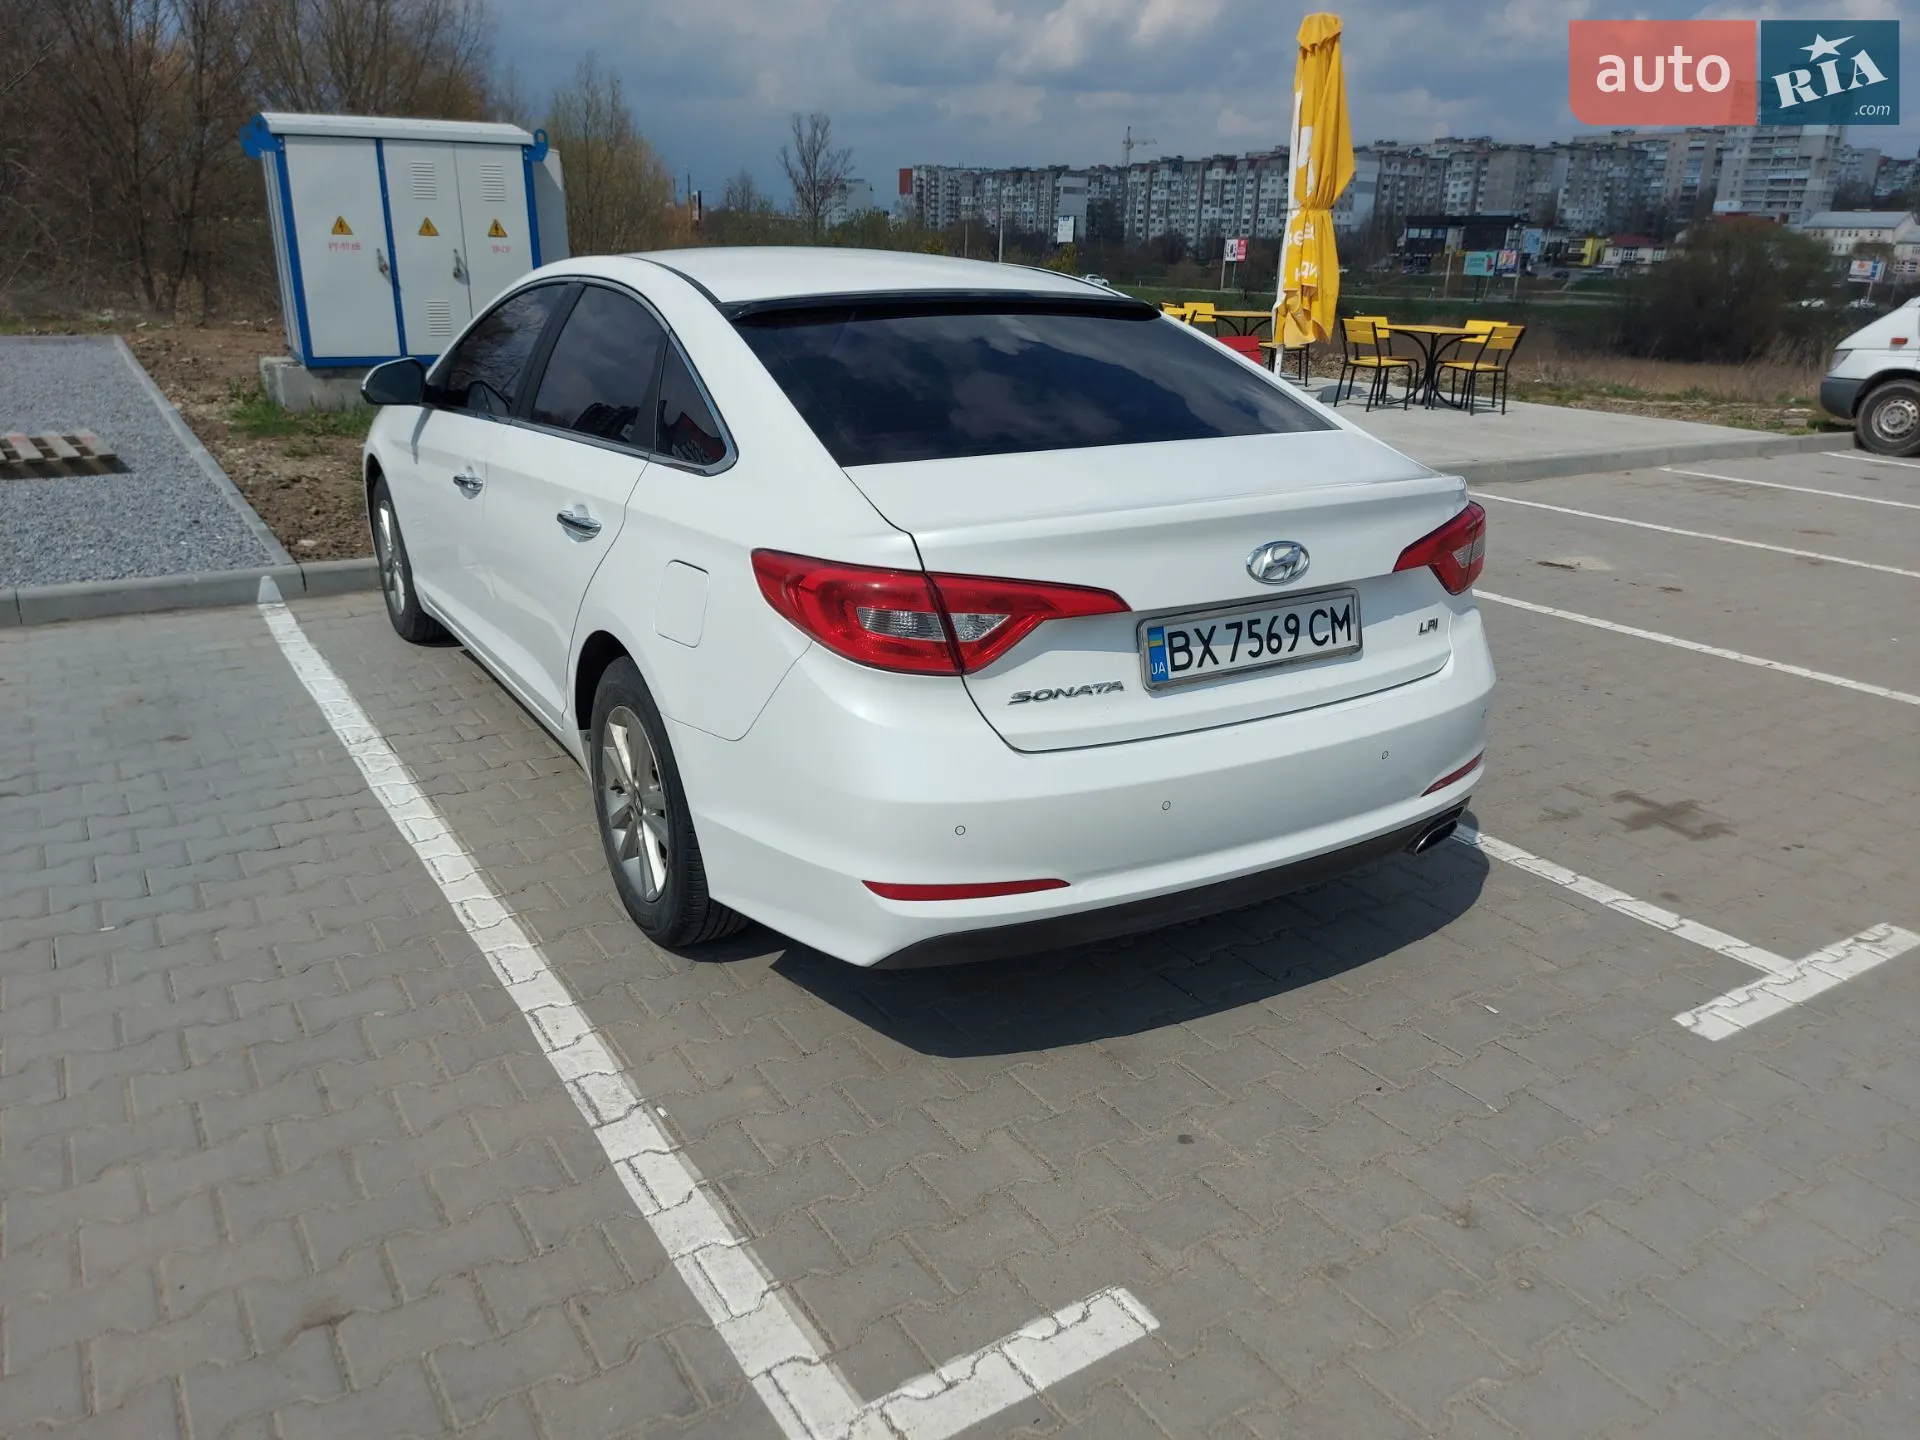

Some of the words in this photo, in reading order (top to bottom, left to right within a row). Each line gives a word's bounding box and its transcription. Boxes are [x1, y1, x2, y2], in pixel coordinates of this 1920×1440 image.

[1167, 625, 1220, 672] BX
[1225, 613, 1301, 662] 7569
[1308, 603, 1352, 647] CM
[1151, 661, 1167, 675] UA
[1007, 680, 1124, 706] SONATA
